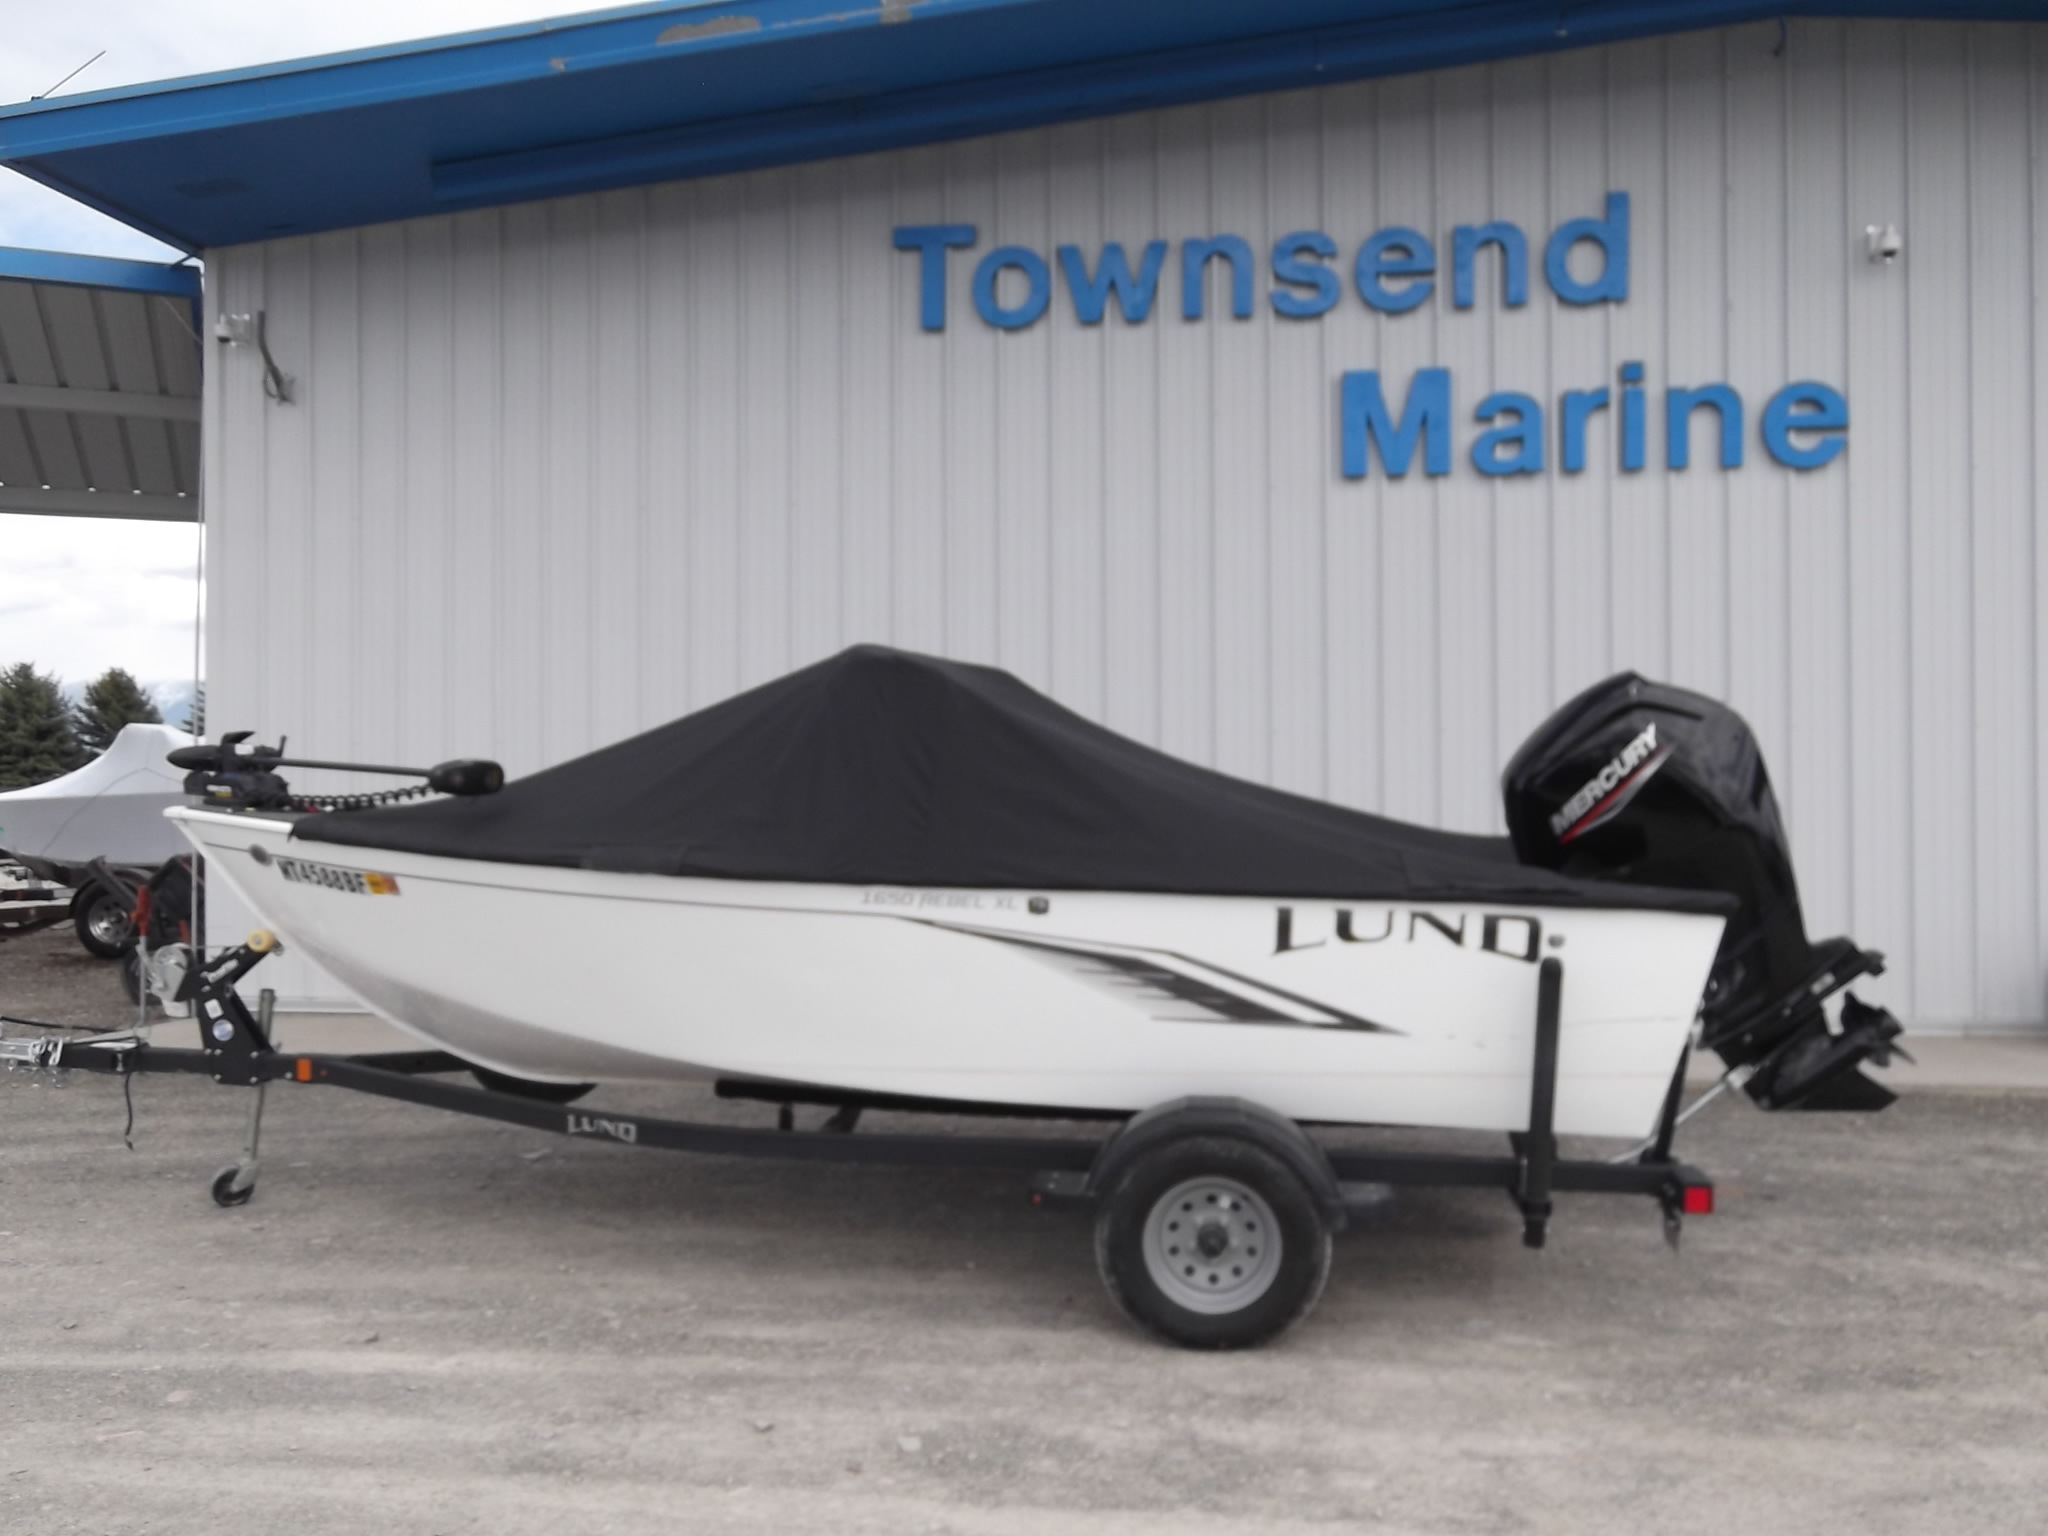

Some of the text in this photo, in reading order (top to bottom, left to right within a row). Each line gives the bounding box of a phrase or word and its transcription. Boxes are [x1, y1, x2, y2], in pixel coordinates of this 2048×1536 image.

[892, 191, 1630, 330] Townsend
[1341, 363, 1849, 477] Marine
[1551, 721, 1657, 836] MERCURY
[861, 888, 915, 906] 1650
[918, 890, 986, 910] REBEL
[993, 895, 1020, 911] XL
[1271, 906, 1542, 964] LUND
[566, 1113, 637, 1144] LUND
